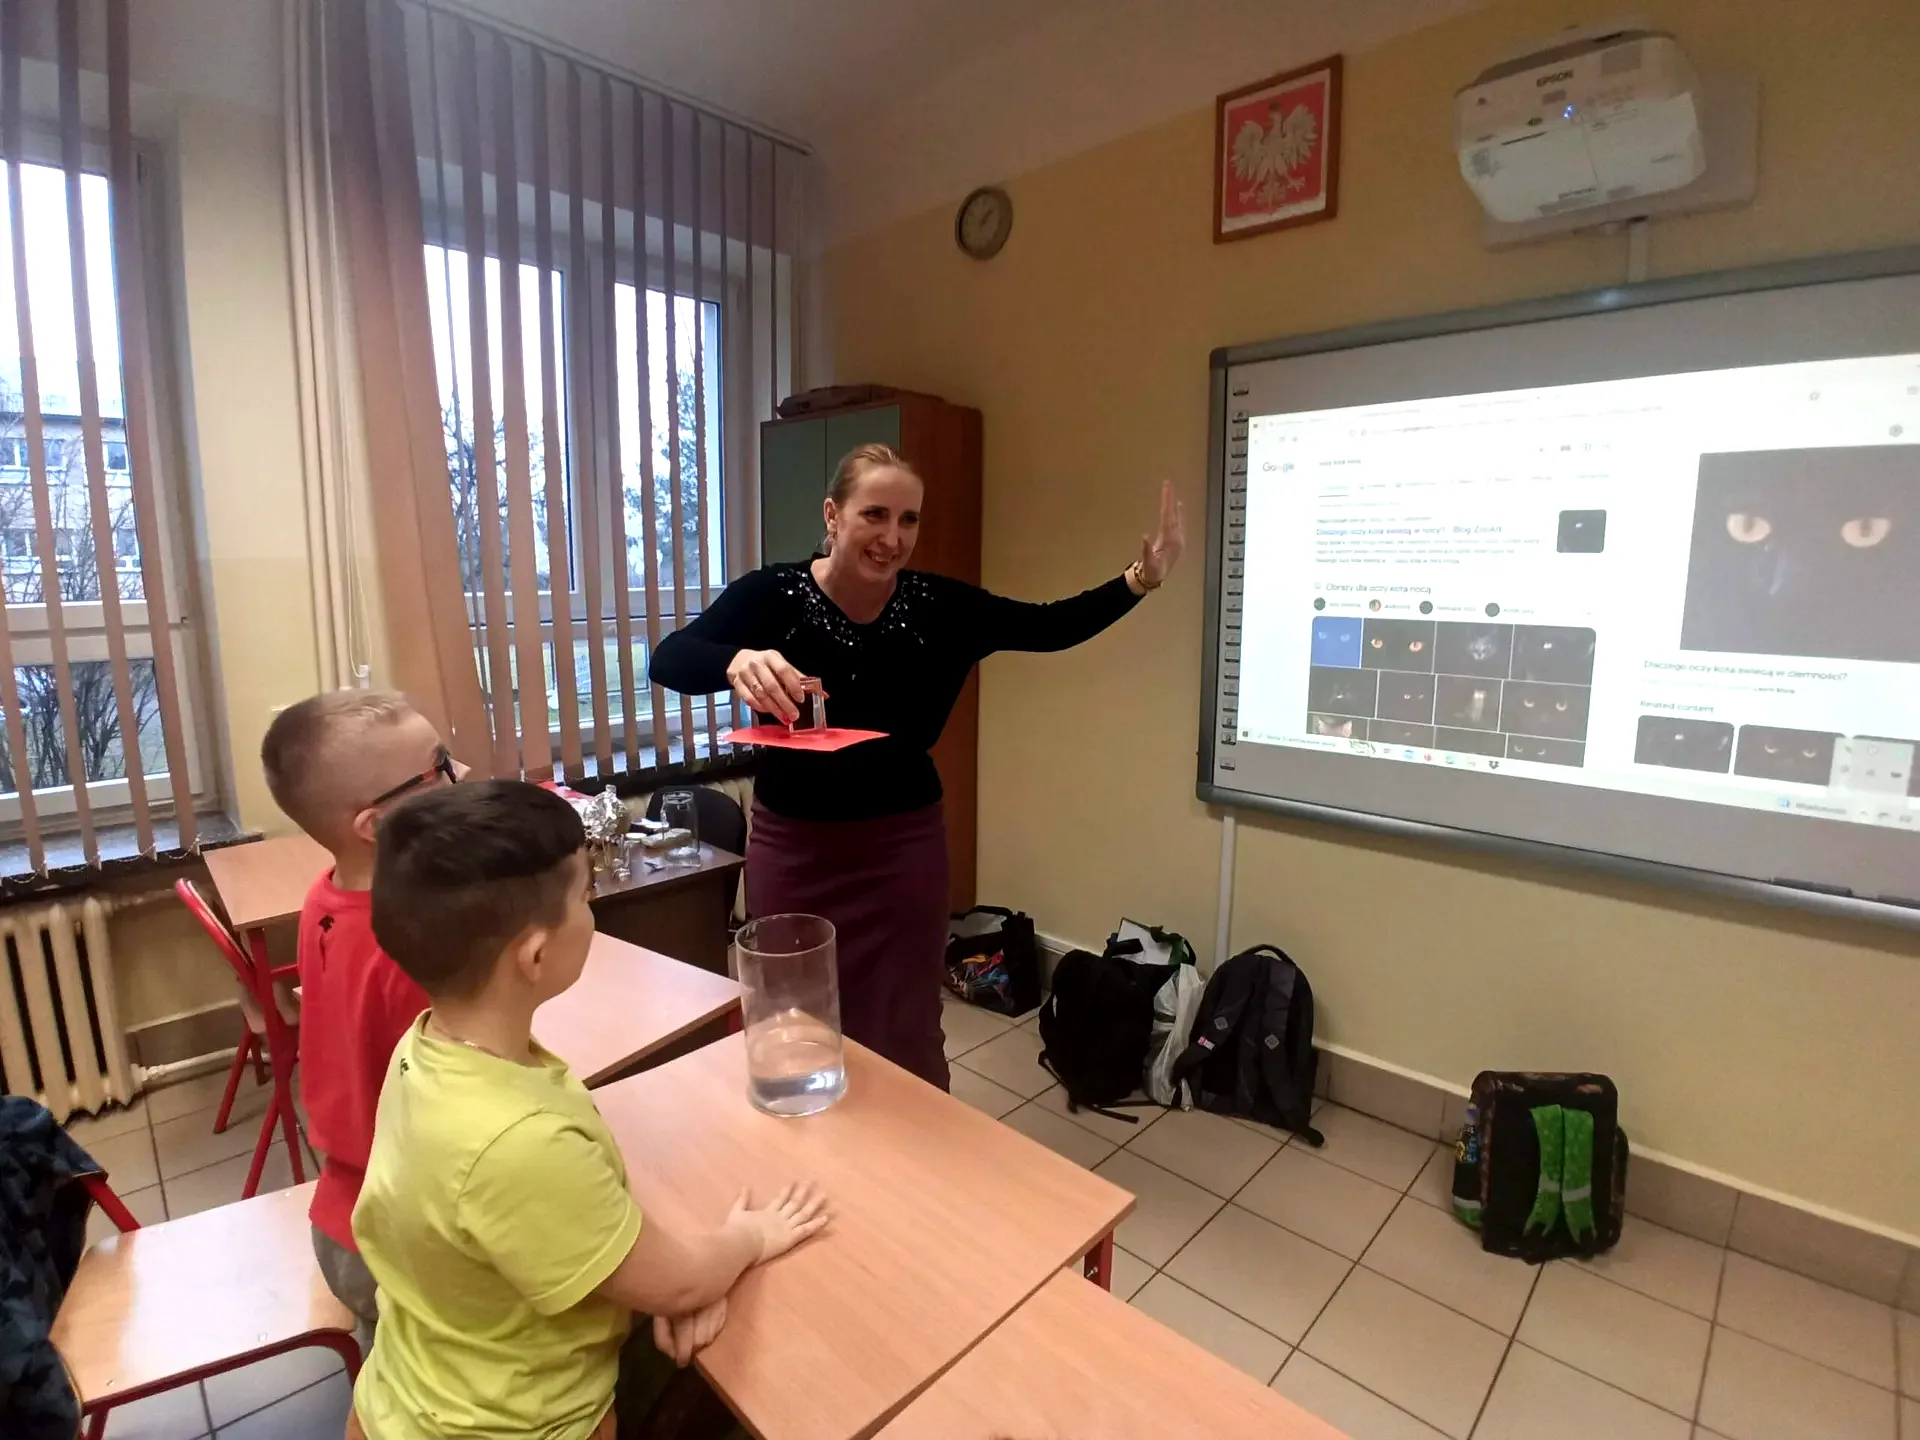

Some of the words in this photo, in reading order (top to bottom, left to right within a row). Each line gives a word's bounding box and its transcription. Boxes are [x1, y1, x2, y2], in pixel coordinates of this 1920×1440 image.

[1536, 69, 1574, 88] EPSON
[1326, 583, 1353, 593] Obrazy
[1355, 584, 1368, 592] dla
[1644, 659, 1687, 672] Dlaczego
[1688, 664, 1712, 674] oczy
[1713, 665, 1736, 674] kota
[1640, 699, 1675, 710] Related
[1676, 703, 1714, 714] content
